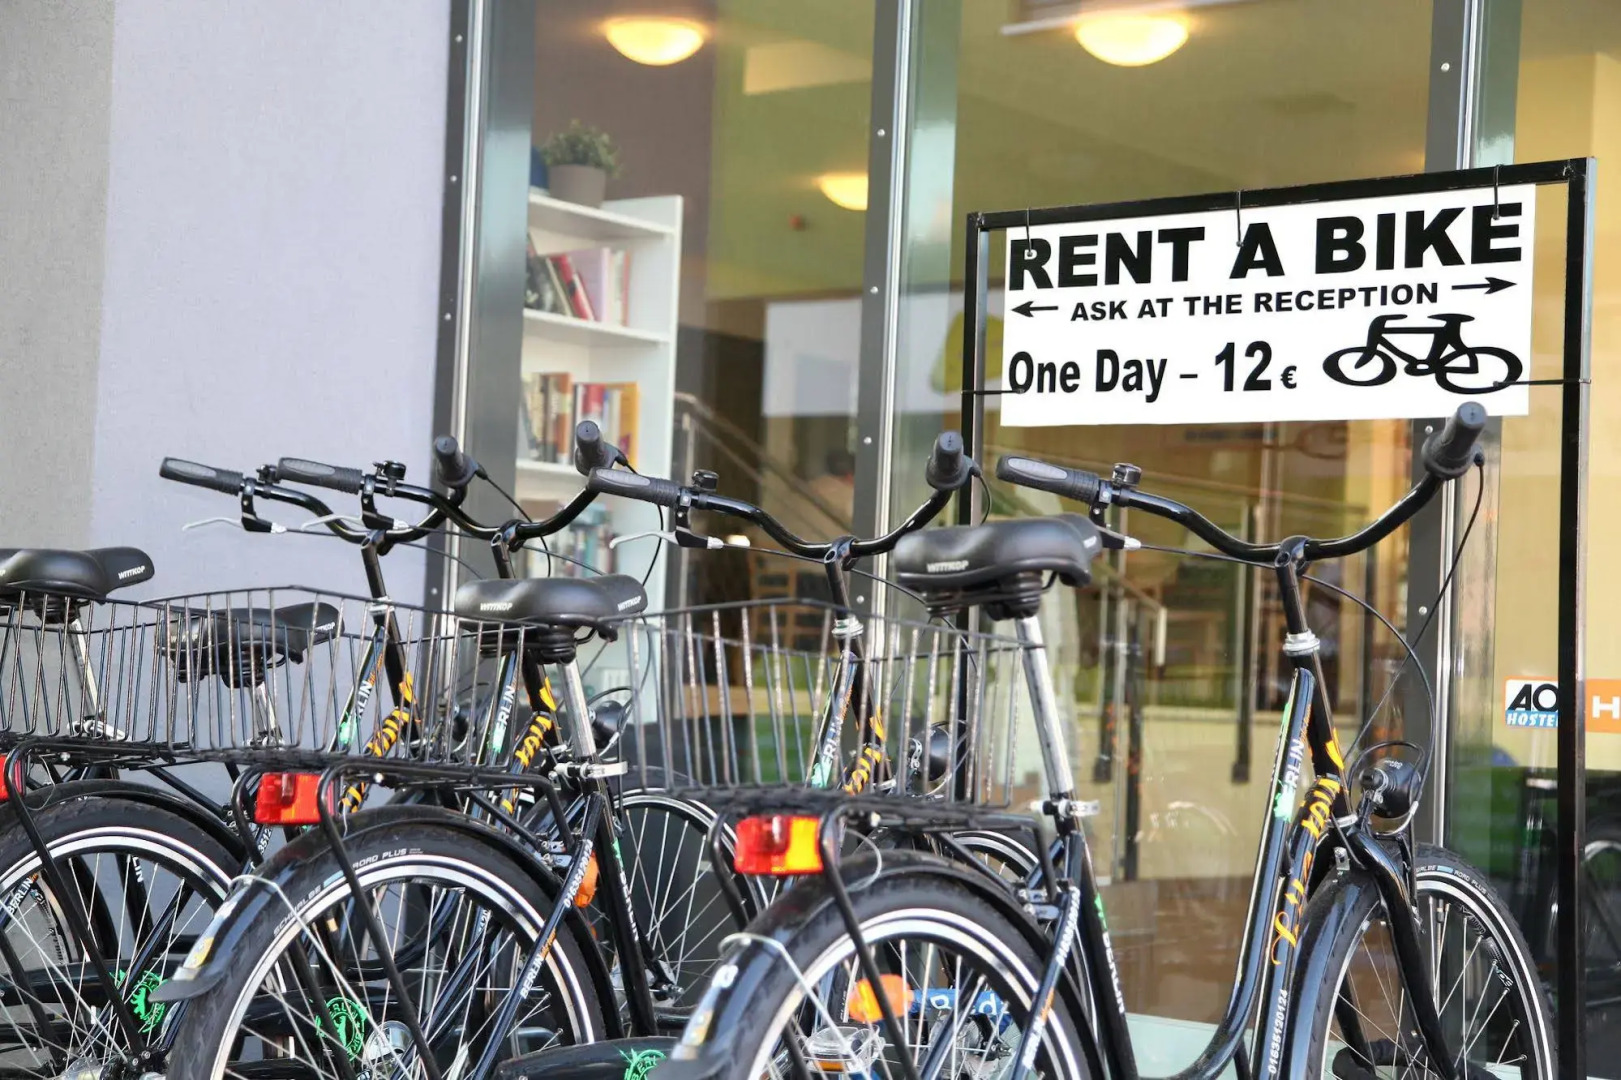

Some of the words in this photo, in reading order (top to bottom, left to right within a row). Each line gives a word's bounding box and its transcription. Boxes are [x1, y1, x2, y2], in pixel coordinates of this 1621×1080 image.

[1009, 226, 1206, 291] RENT
[1229, 221, 1285, 279] A
[1315, 202, 1523, 275] BIKE
[1070, 299, 1128, 322] ASK
[1137, 297, 1174, 319] AT
[1183, 294, 1242, 316] THE
[1254, 282, 1439, 313] RECEPTION
[1007, 350, 1082, 394] One
[1094, 348, 1169, 403] Day
[118, 565, 146, 580] WITTKOP
[1506, 712, 1558, 727] HOSTE
[7, 876, 33, 917] BERLIN
[519, 952, 544, 1000] BERLIN
